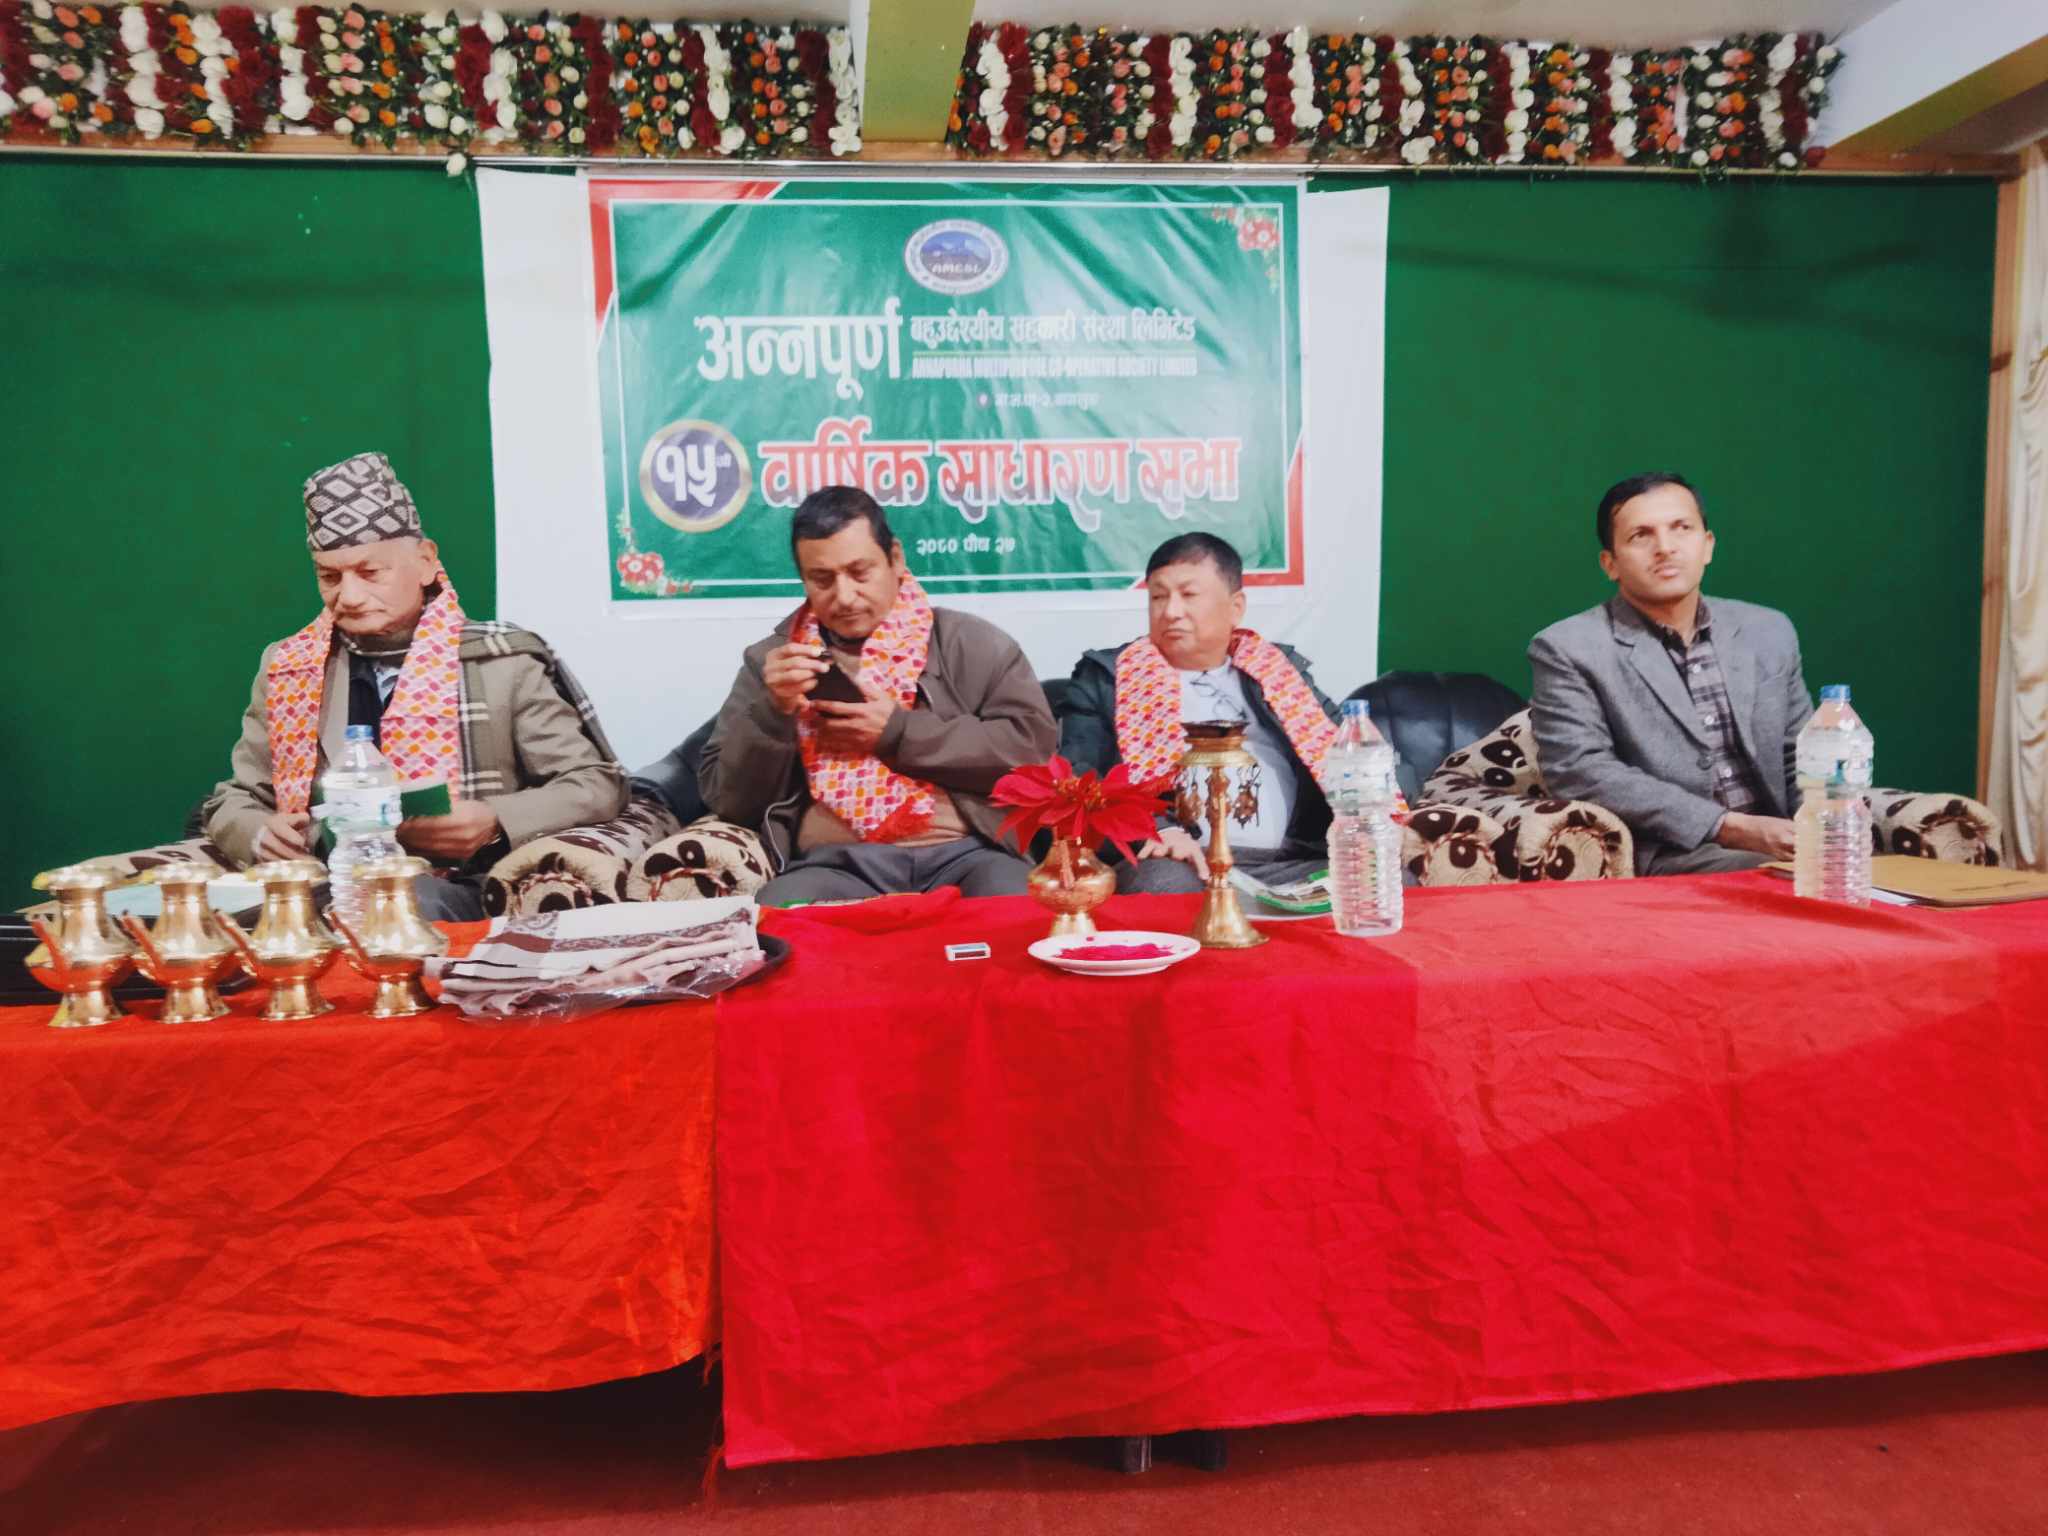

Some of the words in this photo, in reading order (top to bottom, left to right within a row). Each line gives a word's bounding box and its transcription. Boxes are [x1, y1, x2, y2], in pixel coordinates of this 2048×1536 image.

[693, 296, 903, 401] अन्नपूर्ण
[1009, 309, 1077, 343] सहकारी
[1131, 307, 1196, 342] लिमिटेड
[758, 416, 931, 508] वार्षिक
[934, 437, 1131, 533] साधारण
[1134, 436, 1241, 519] सभा
